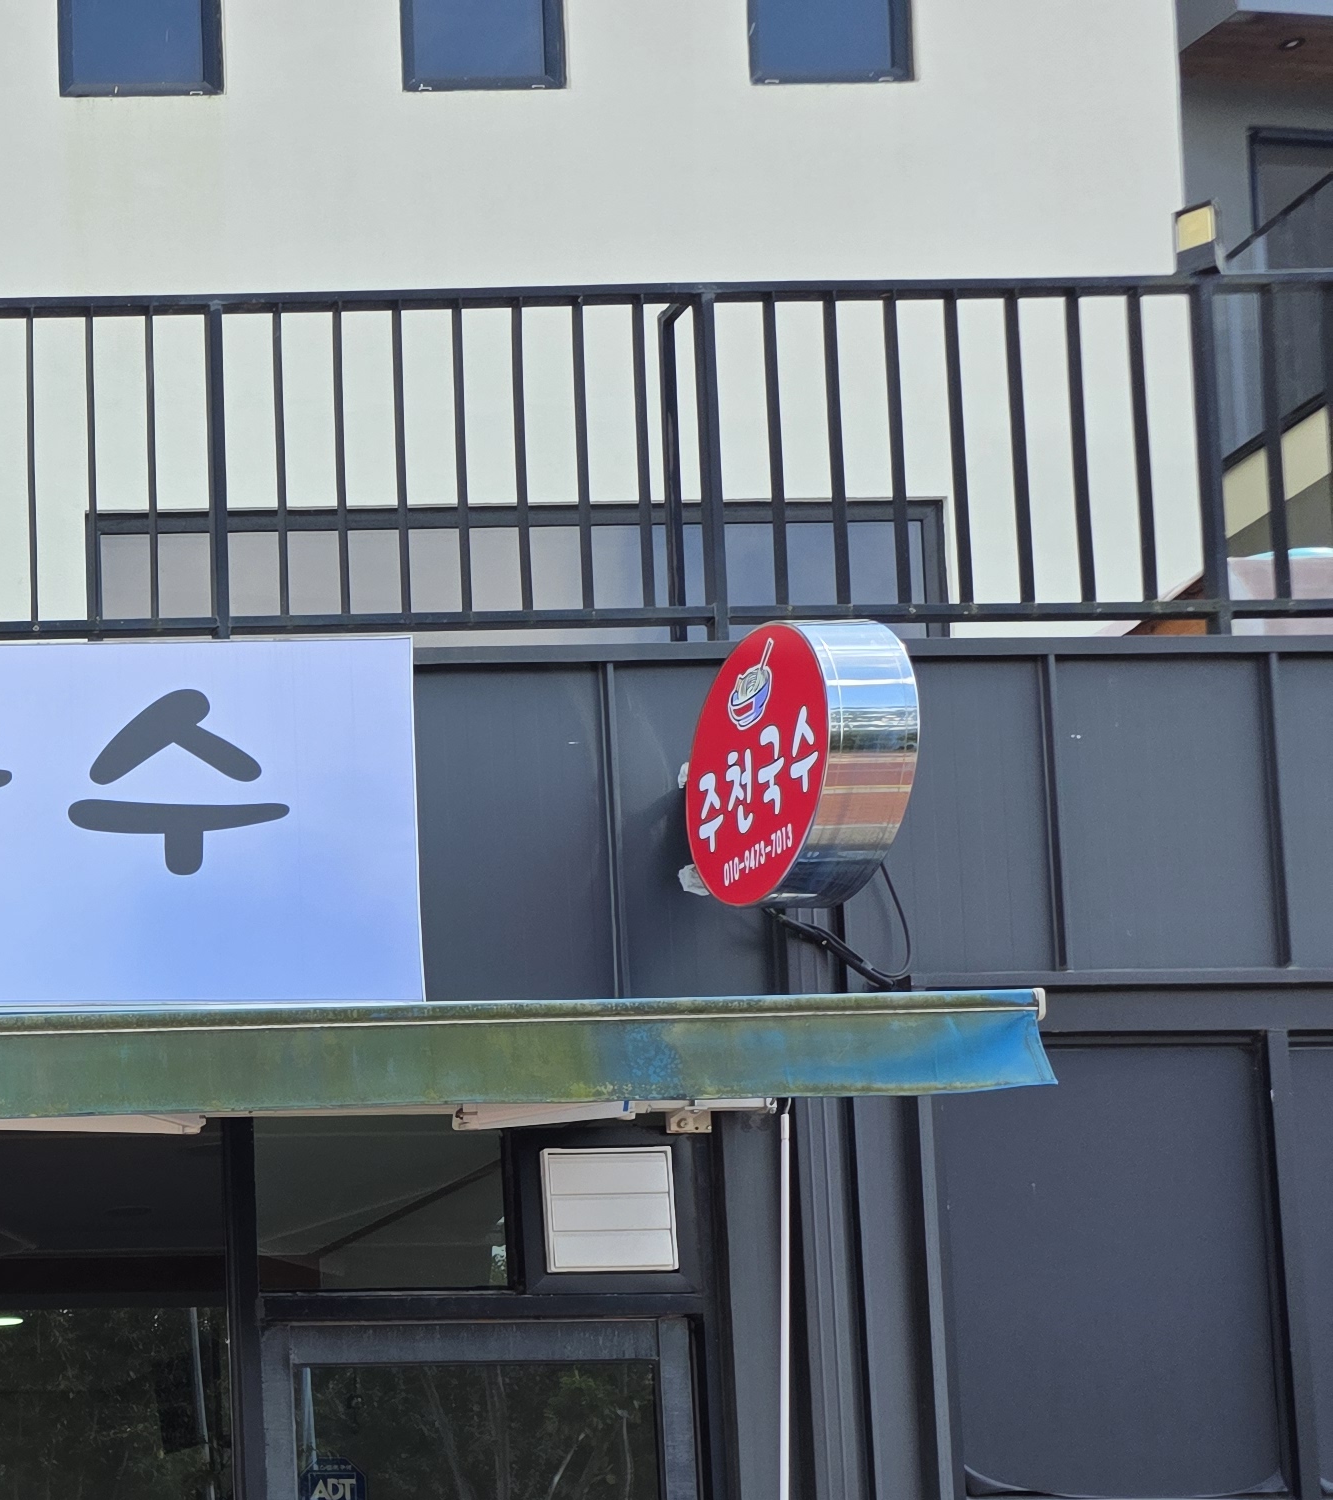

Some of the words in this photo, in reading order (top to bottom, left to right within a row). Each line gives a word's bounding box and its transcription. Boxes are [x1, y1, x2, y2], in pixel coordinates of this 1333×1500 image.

[699, 706, 818, 852] 주천국수
[724, 823, 793, 886] 010-9473-7013
[310, 1478, 356, 1500] ADT
